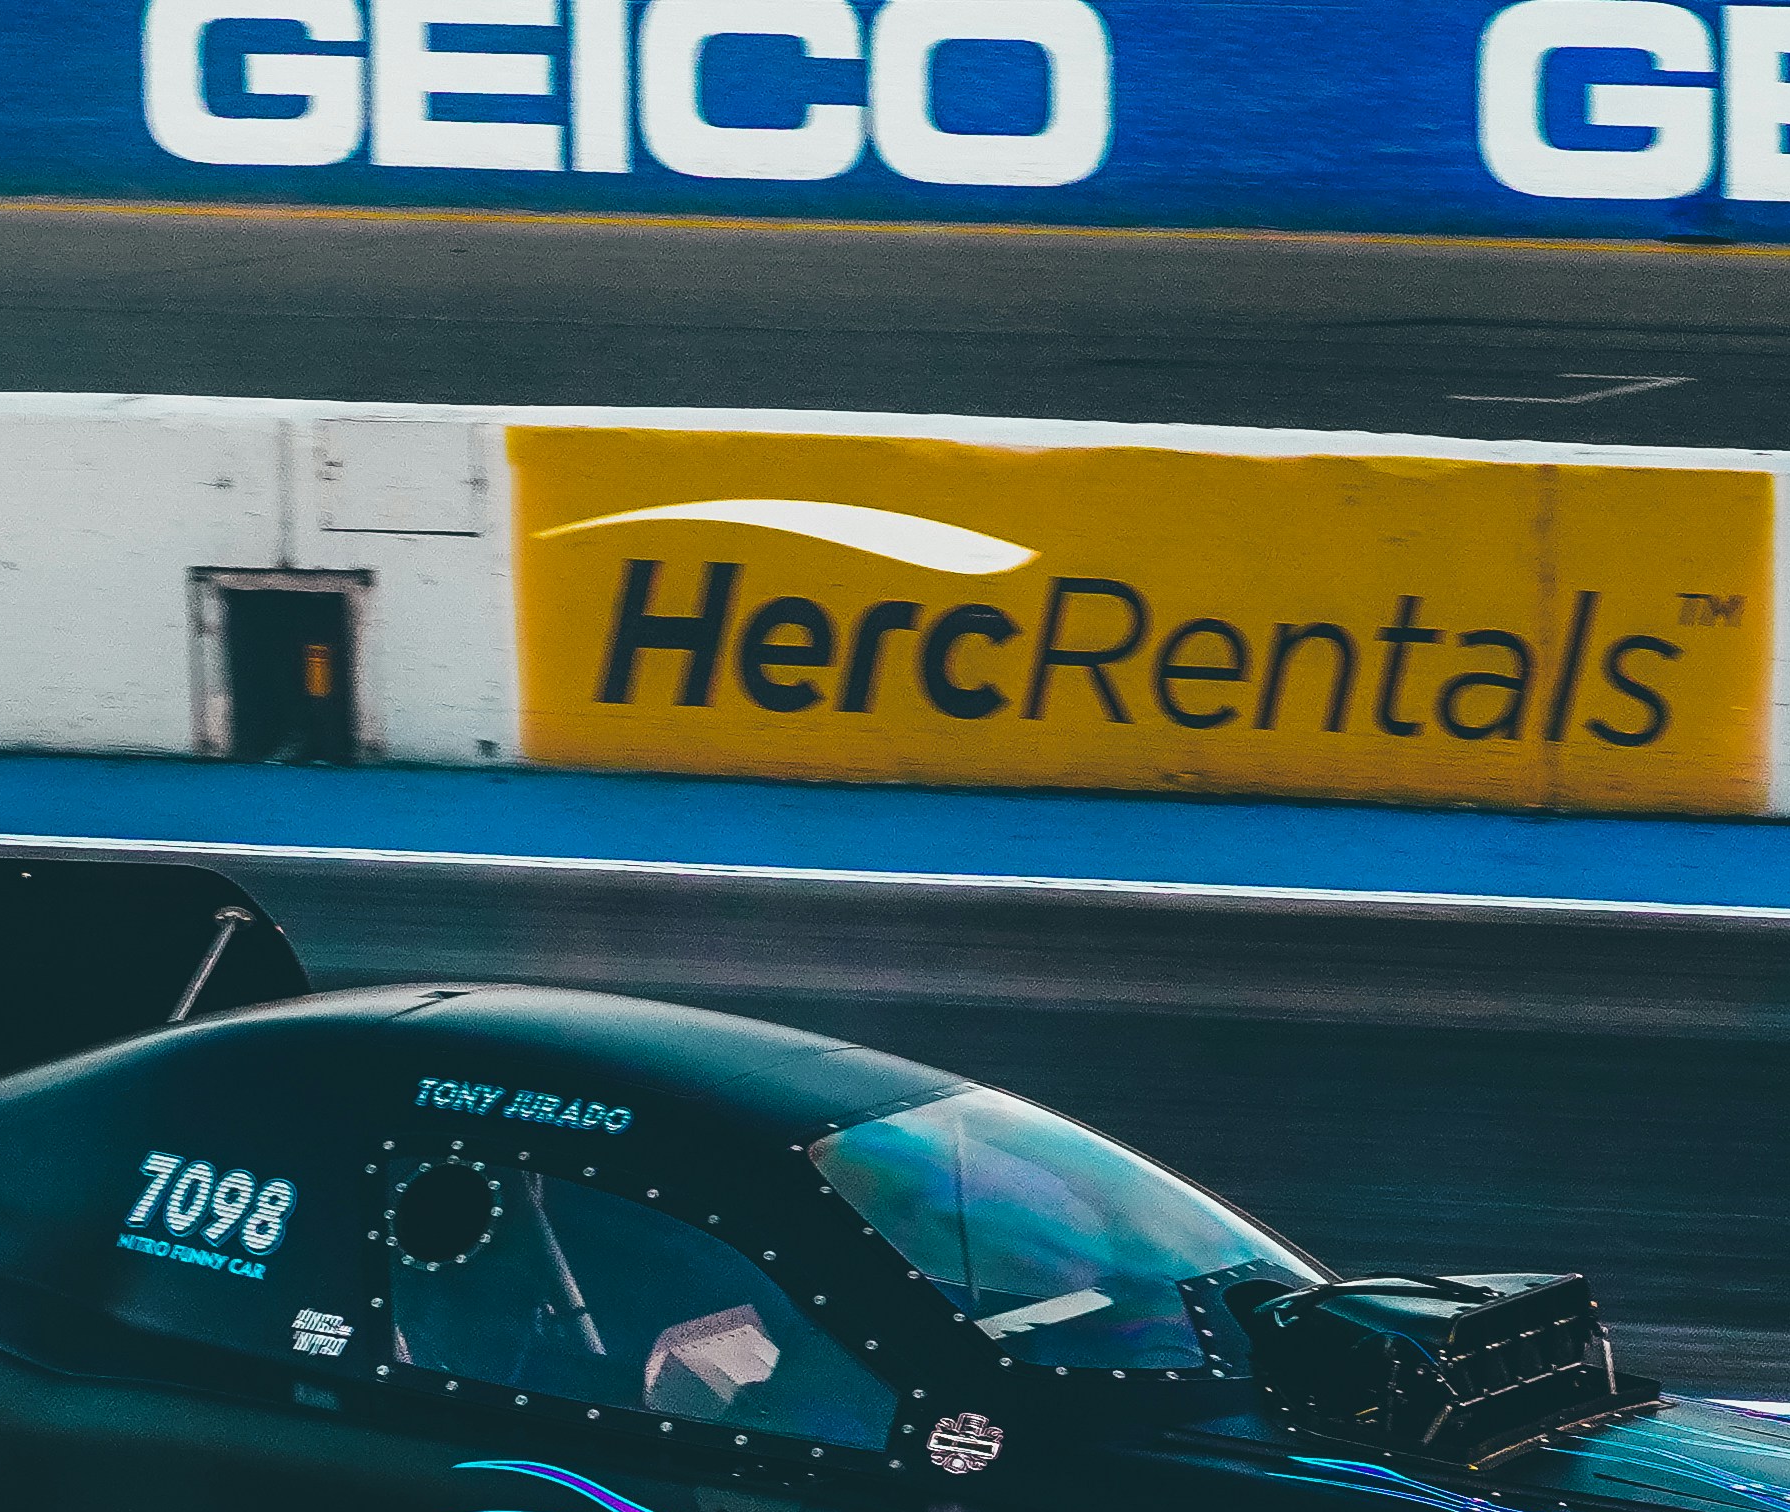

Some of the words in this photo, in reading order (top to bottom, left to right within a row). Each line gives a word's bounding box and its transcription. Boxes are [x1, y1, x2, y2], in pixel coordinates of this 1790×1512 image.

[143, 0, 1112, 186] GEICO
[596, 558, 1682, 746] HercRentals
[414, 1077, 507, 1116] TONY
[502, 1090, 635, 1135] JURADO
[124, 1150, 297, 1256] 7098
[227, 1258, 267, 1281] CAR
